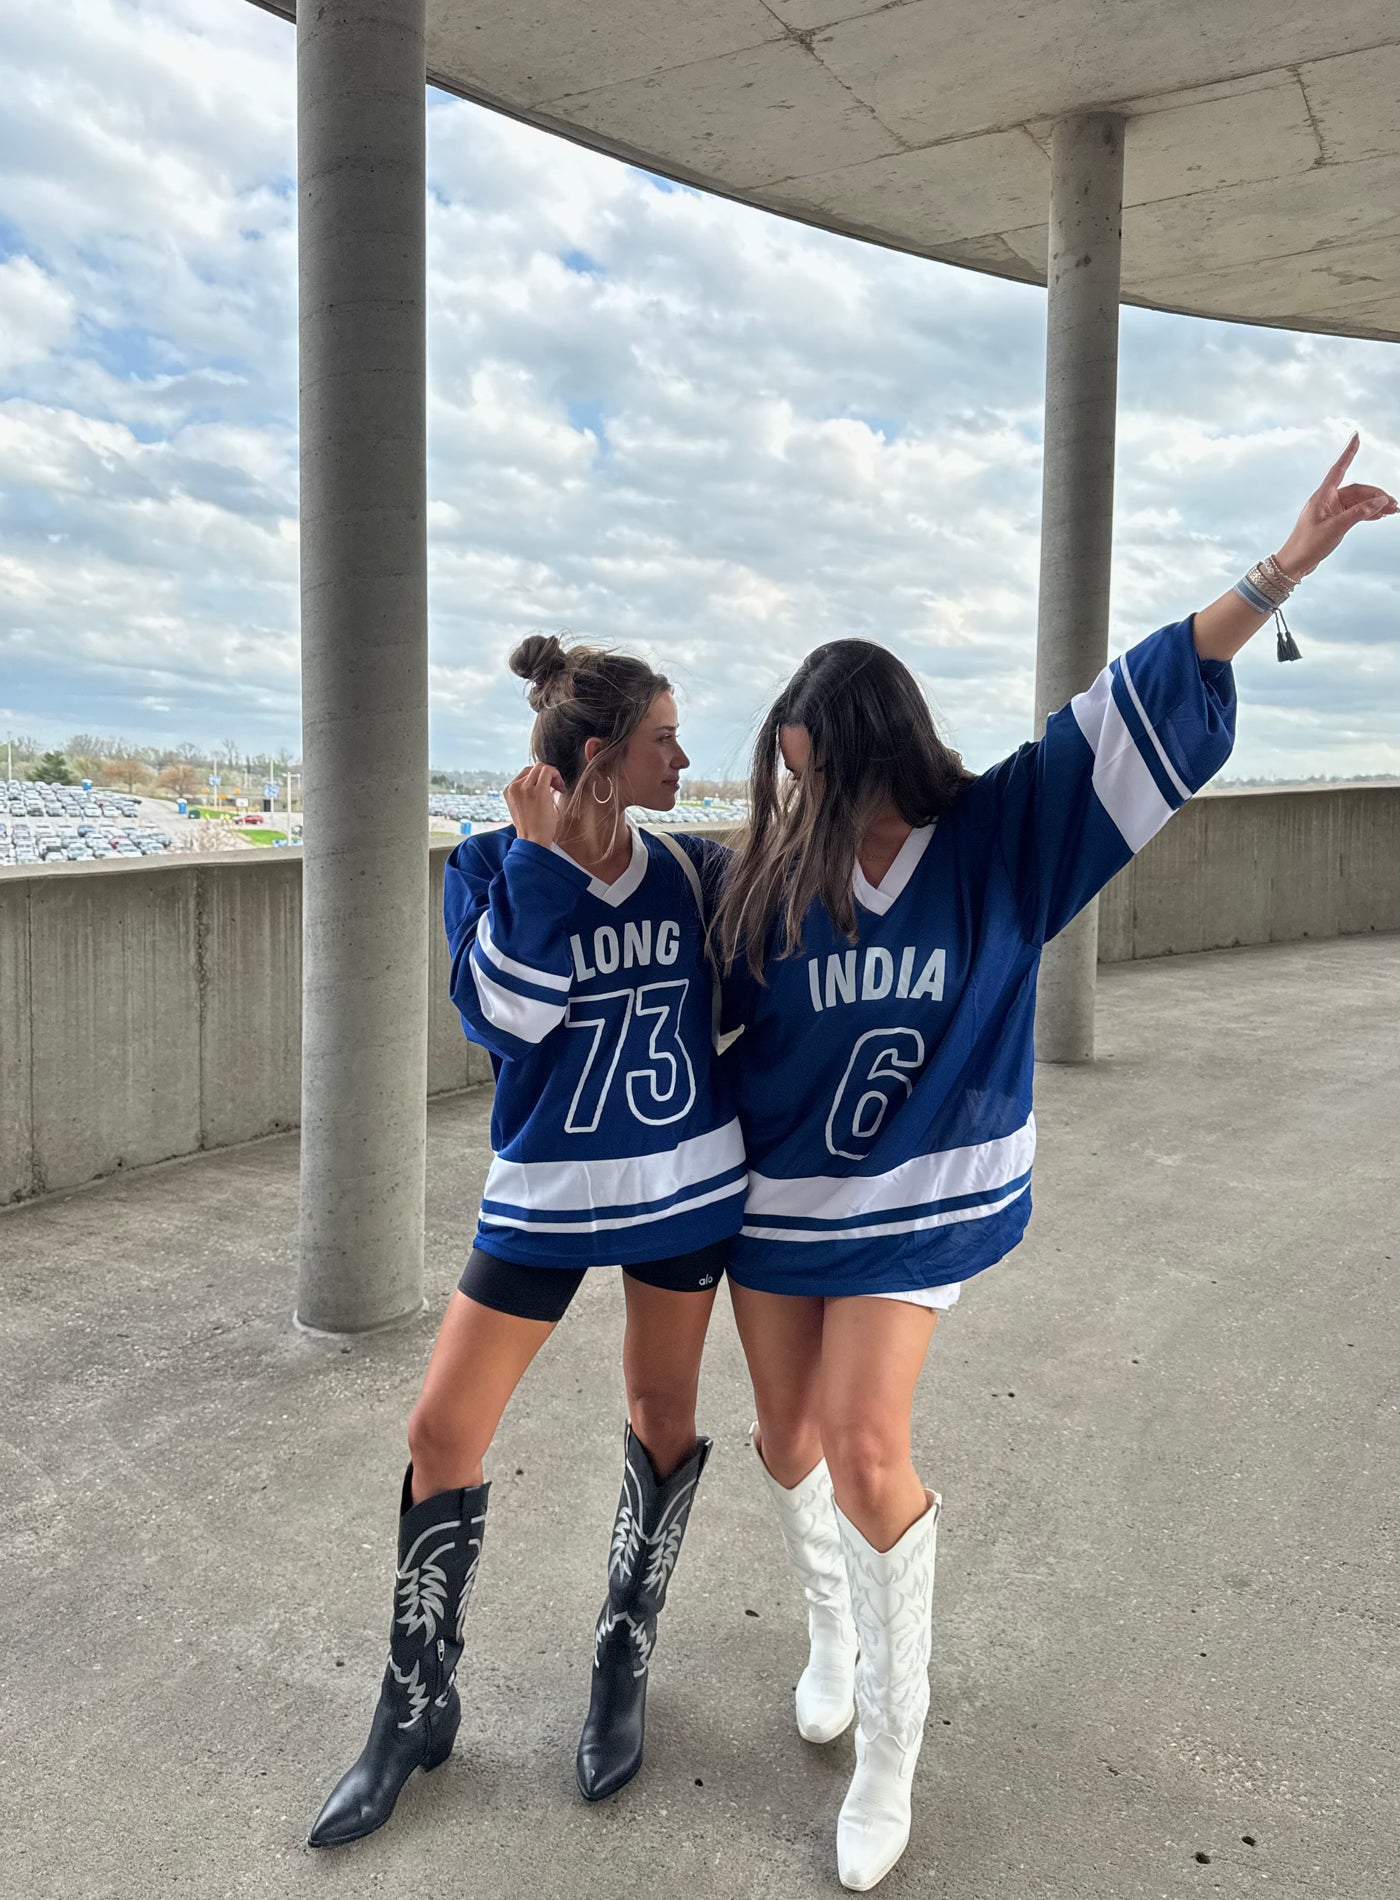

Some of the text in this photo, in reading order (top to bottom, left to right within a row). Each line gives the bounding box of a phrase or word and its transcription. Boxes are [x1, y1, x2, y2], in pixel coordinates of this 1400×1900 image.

[569, 919, 681, 983] LONG
[808, 946, 947, 1012] INDIA
[564, 978, 696, 1134] 73
[825, 1026, 926, 1161] 6
[698, 1273, 714, 1286] alo
